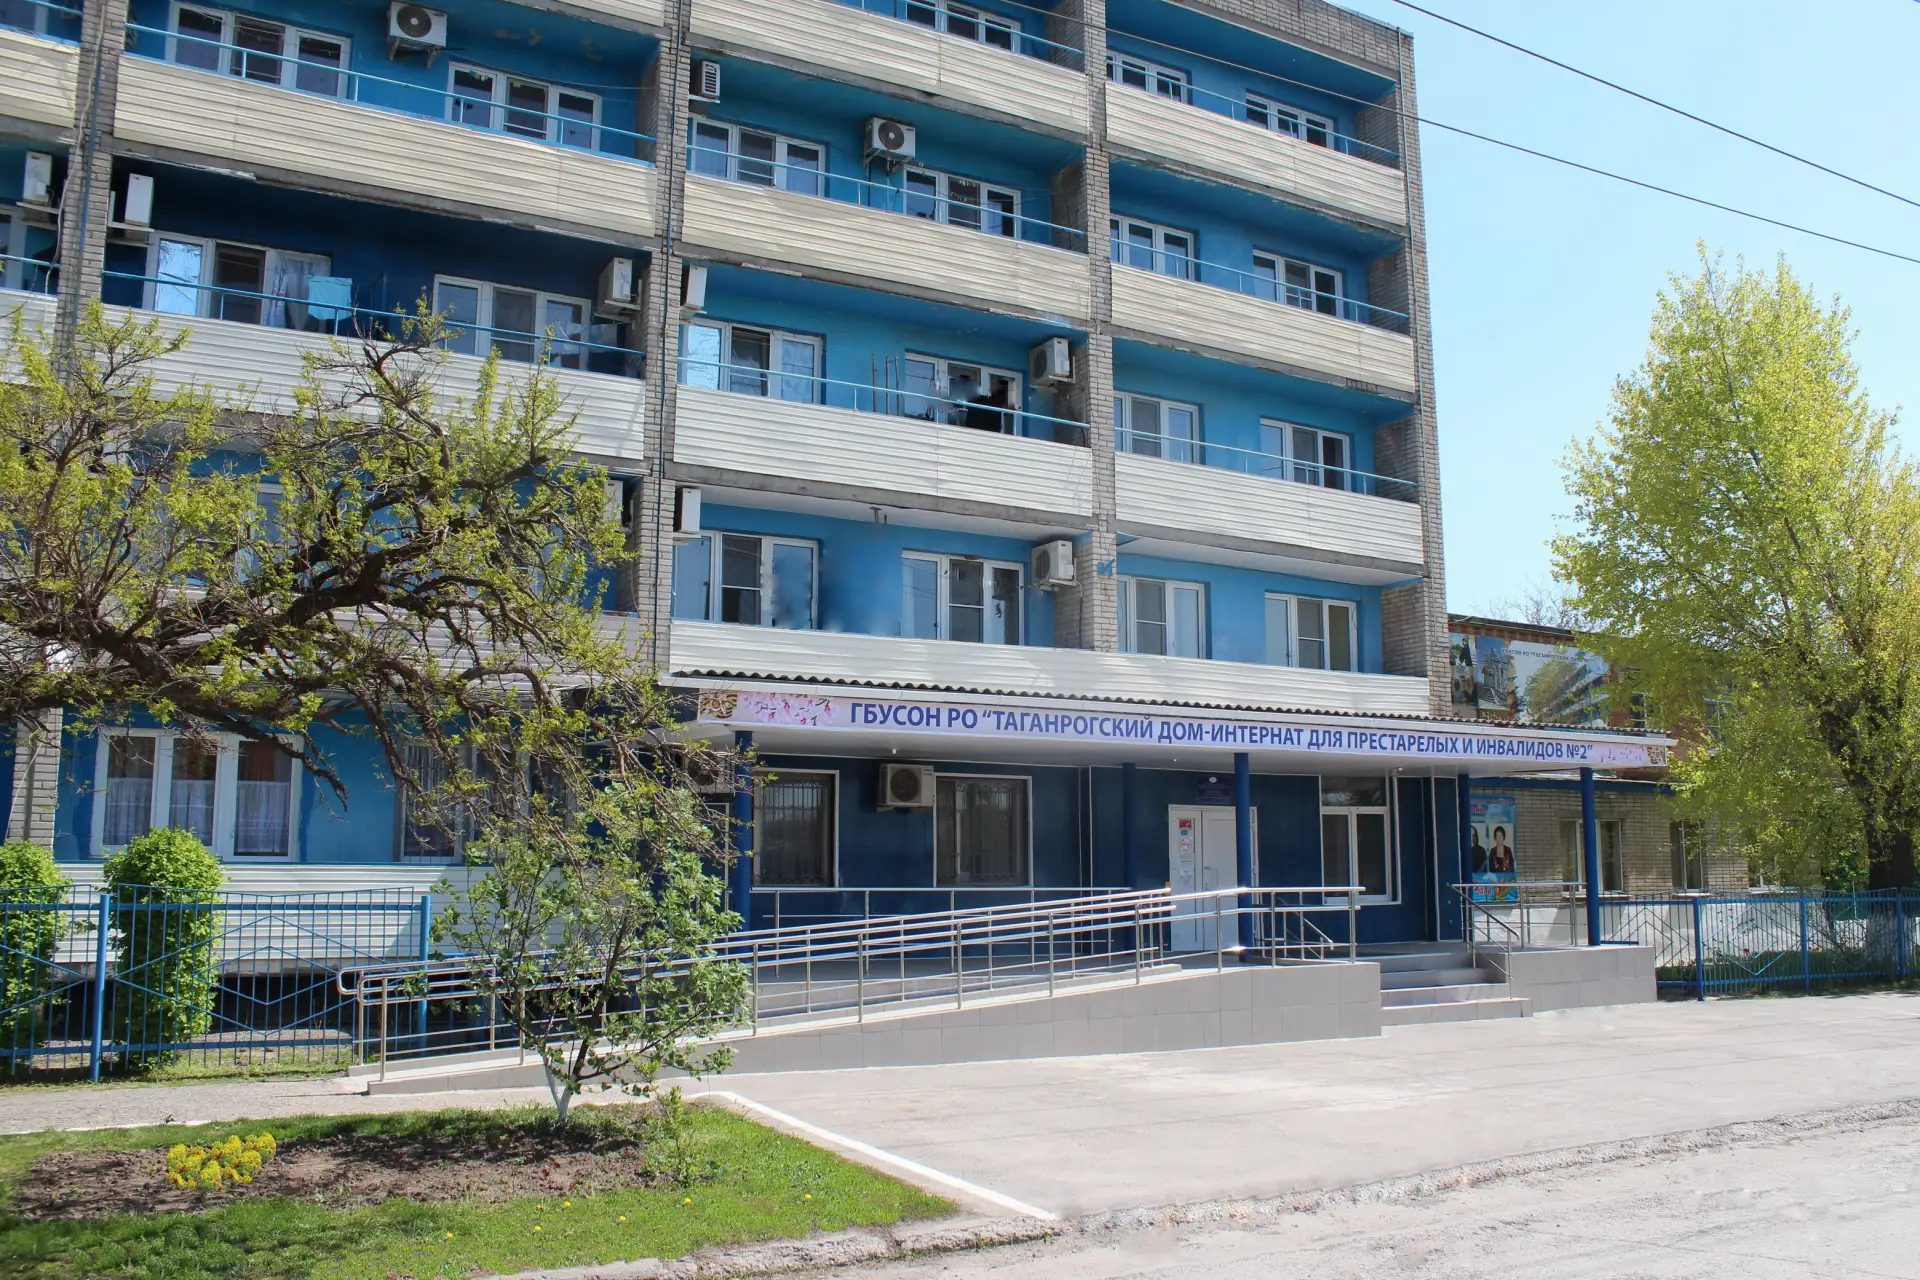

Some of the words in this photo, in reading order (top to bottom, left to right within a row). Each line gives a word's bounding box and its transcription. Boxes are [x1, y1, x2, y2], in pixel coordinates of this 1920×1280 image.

[850, 702, 941, 727] ГБУСОН
[948, 708, 978, 729] РО
[1158, 721, 1304, 746] ДОМ-ИНТЕРНАТ
[1307, 729, 1343, 750] ДЛЯ
[1347, 731, 1459, 754] ПРЕСТАРЕЛЫХ
[1462, 737, 1473, 754] И
[1477, 738, 1564, 760] ИНВАЛИДОВ
